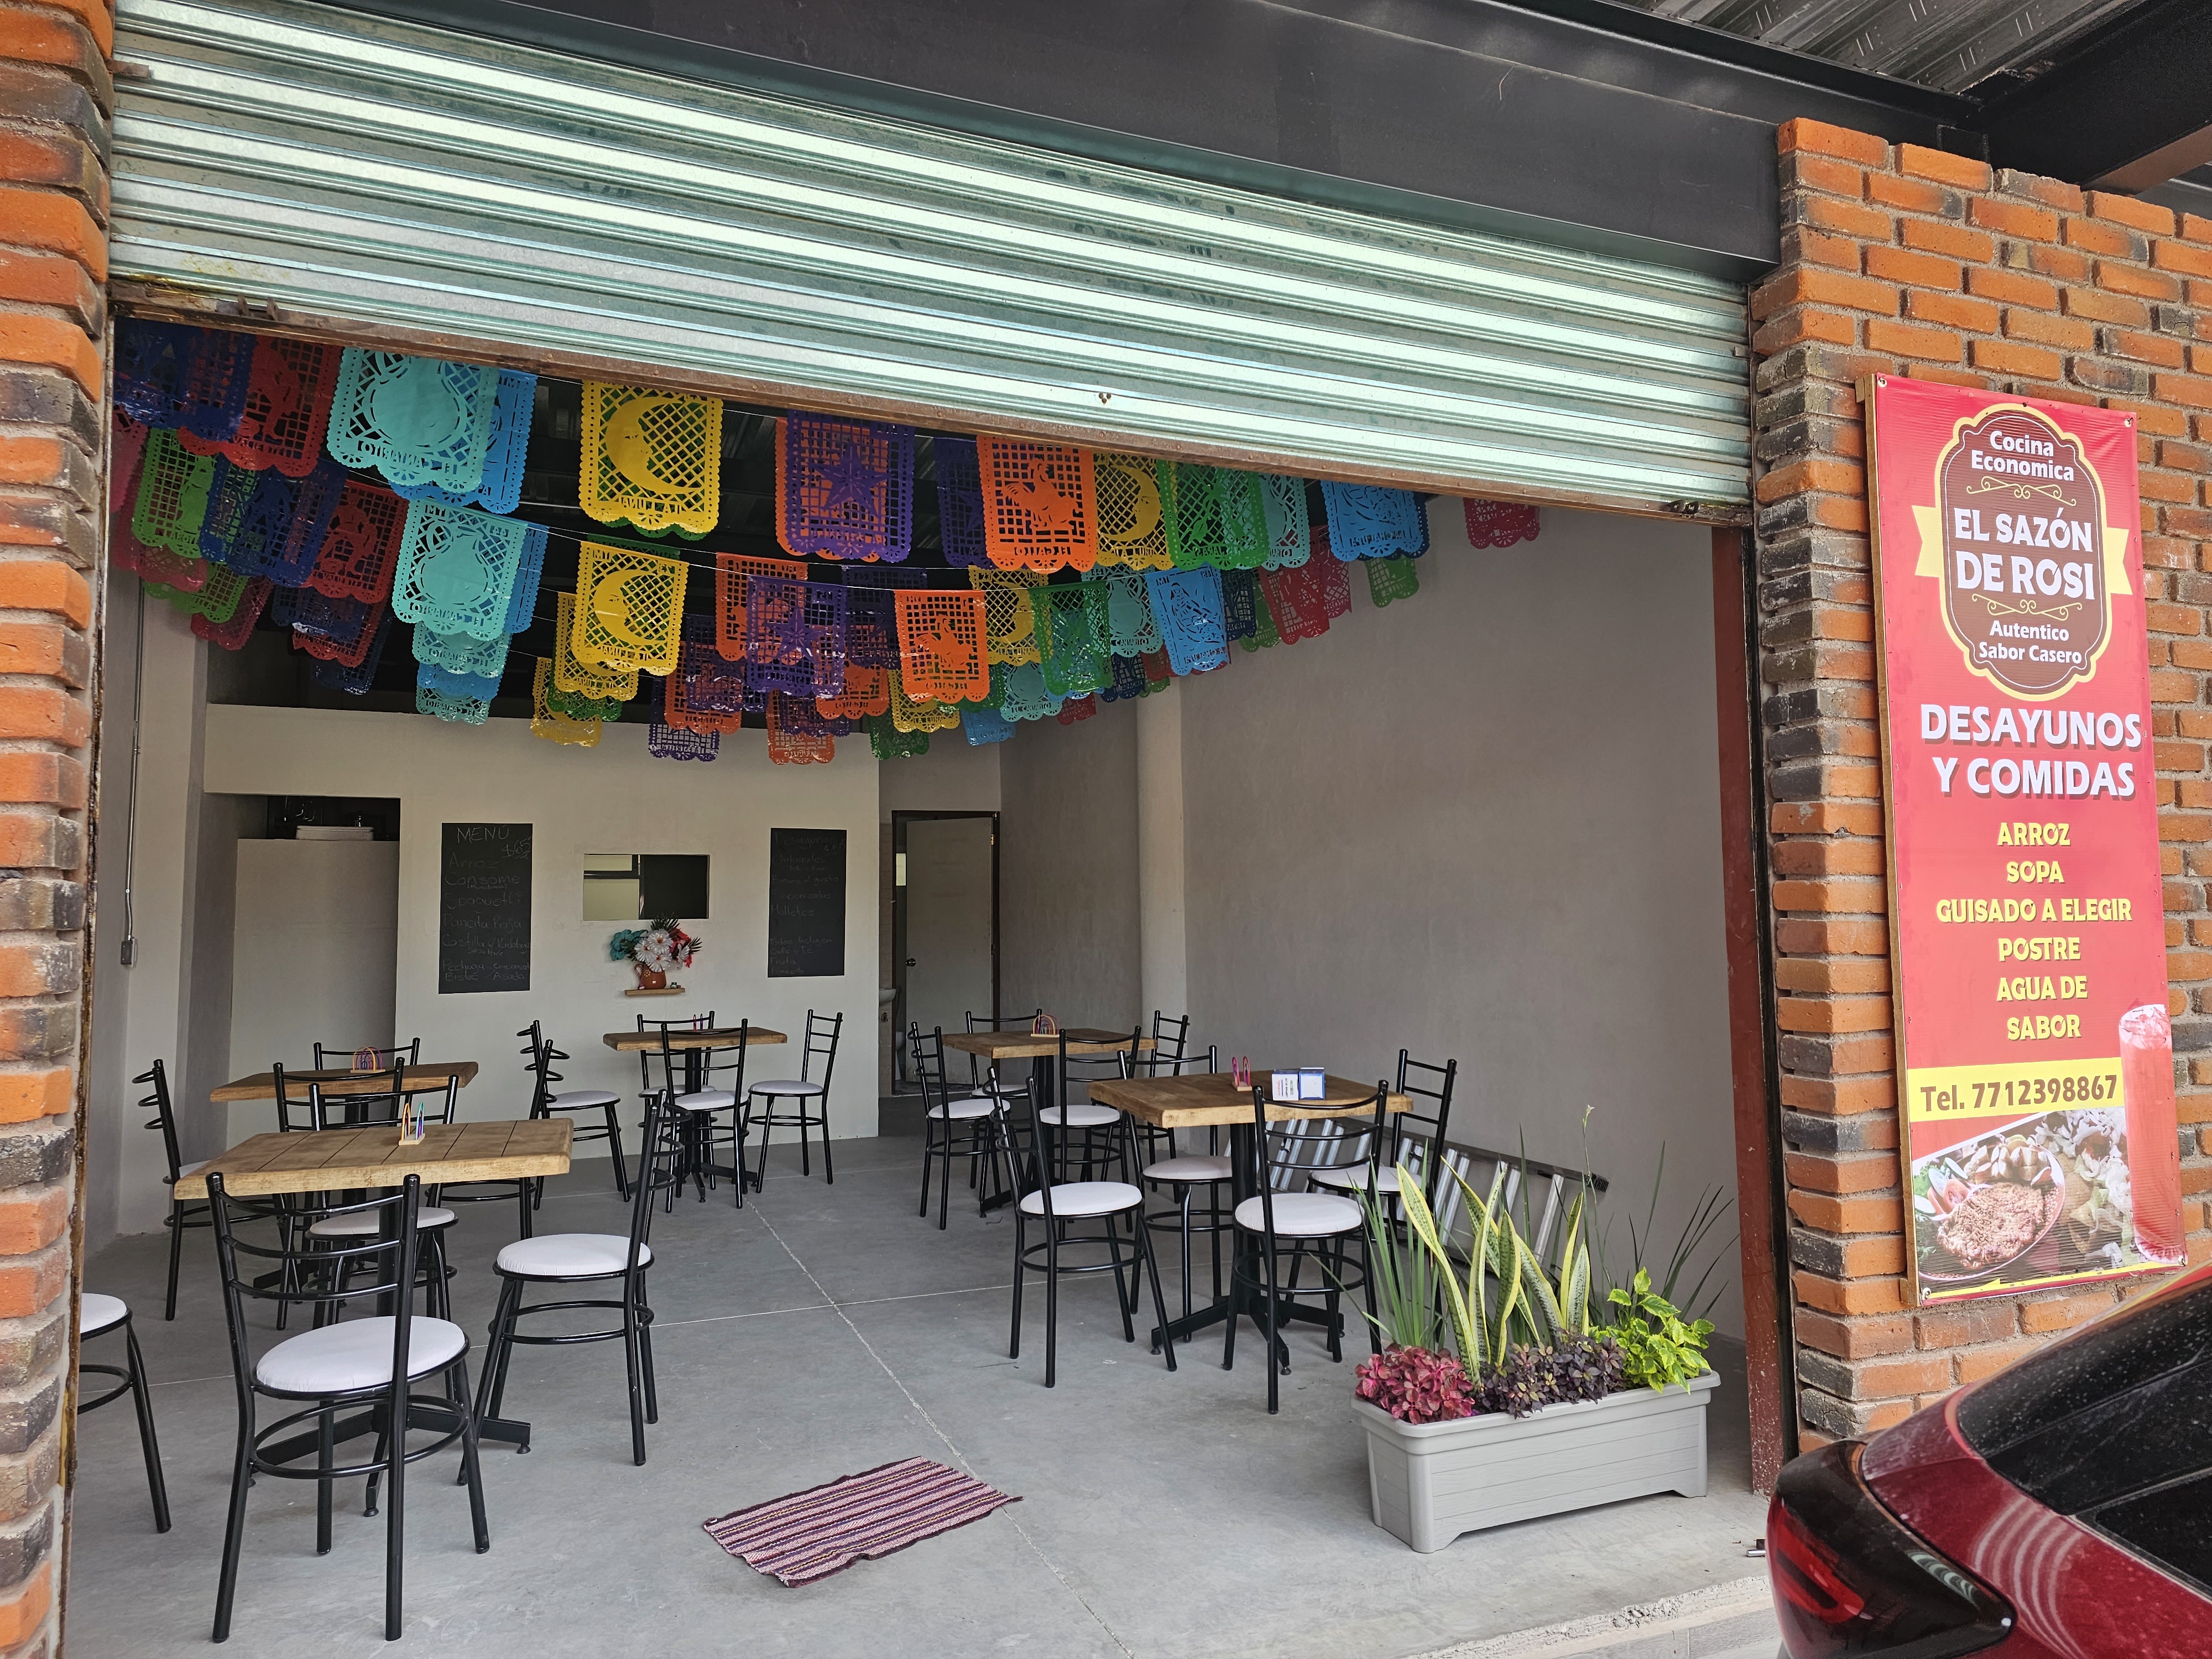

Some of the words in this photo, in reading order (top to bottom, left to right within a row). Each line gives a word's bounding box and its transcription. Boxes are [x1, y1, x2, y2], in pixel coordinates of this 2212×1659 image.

[1990, 430, 2054, 457] Cocina
[1971, 450, 2075, 482] Economica
[1954, 507, 1990, 541] EL
[1996, 507, 2094, 552] SAZÓN
[1955, 551, 2005, 592] DE
[2010, 556, 2095, 600] ROSI
[1989, 620, 2069, 641] Autentico
[1979, 642, 2026, 661] Sabor
[2029, 645, 2083, 665] Casero
[1921, 704, 2142, 749] DESAYUNOS
[1932, 757, 1959, 793] Y
[1967, 758, 2136, 797] COMIDAS
[1997, 822, 2071, 846] ARROZ
[448, 851, 499, 869] Arroz
[2006, 860, 2064, 884] SOPA
[771, 904, 815, 917] Molletes
[1936, 898, 2037, 924] GUISADO
[2041, 902, 2058, 922] A
[2062, 898, 2133, 922] ELEGIR
[442, 932, 485, 947] Costilla
[1998, 936, 2081, 962] POSTRE
[442, 958, 485, 975] Pechuga
[770, 956, 797, 965] Fruta
[1996, 977, 2057, 1001] AGUA
[2060, 975, 2088, 999] DE
[2007, 1014, 2081, 1041] SABOR
[1921, 1085, 1965, 1112] Tel.
[1972, 1074, 2117, 1109] 7712398867
